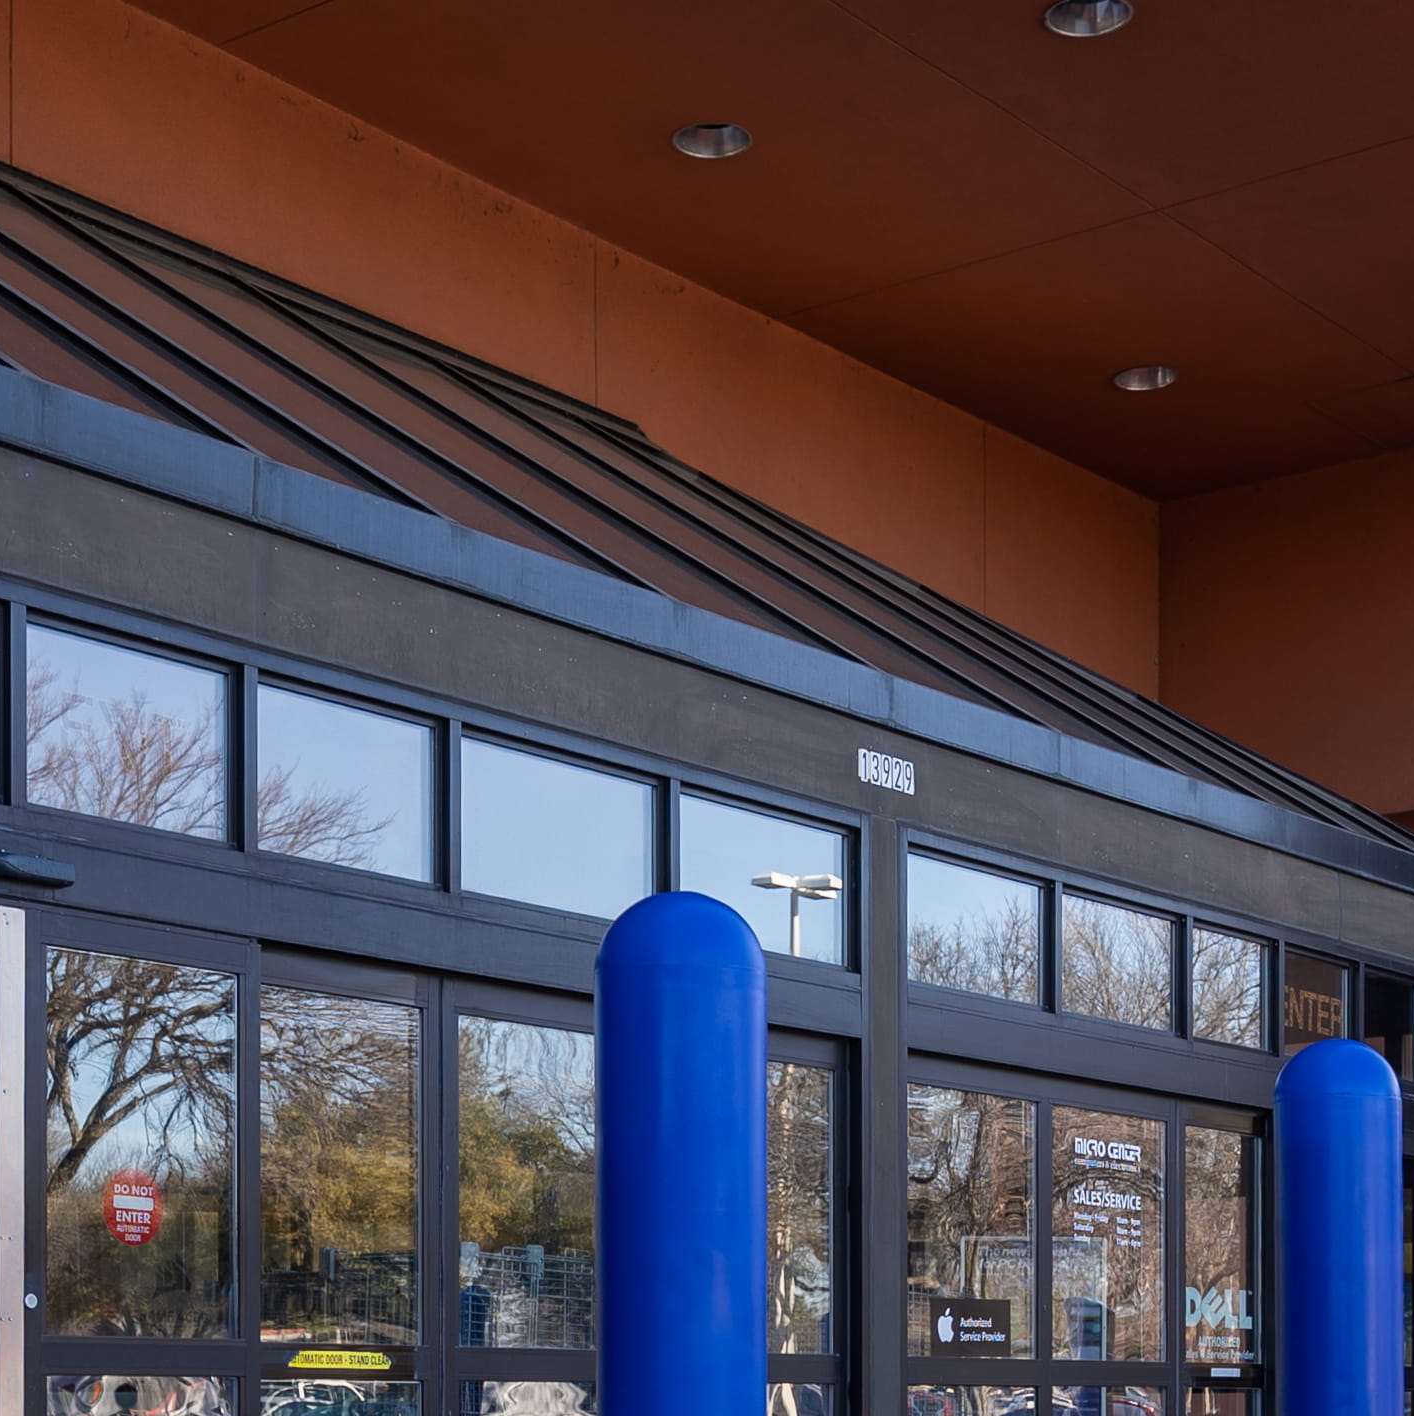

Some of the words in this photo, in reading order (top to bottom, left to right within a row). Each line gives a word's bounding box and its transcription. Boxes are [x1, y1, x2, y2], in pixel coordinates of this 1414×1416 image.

[861, 751, 913, 792] 13929
[1073, 1137, 1106, 1158] MICRO
[1107, 1141, 1141, 1162] CENTER
[114, 1184, 130, 1193] DO
[132, 1185, 153, 1196] NOT
[1073, 1189, 1141, 1211] SALES/SERVICE
[116, 1211, 151, 1224] ENTER
[1185, 1286, 1252, 1329] DELL
[959, 1317, 992, 1328] Authorized
[959, 1330, 981, 1342] Service
[982, 1331, 1006, 1343] Provider
[326, 1354, 343, 1365] DOOR
[349, 1355, 370, 1366] STAND
